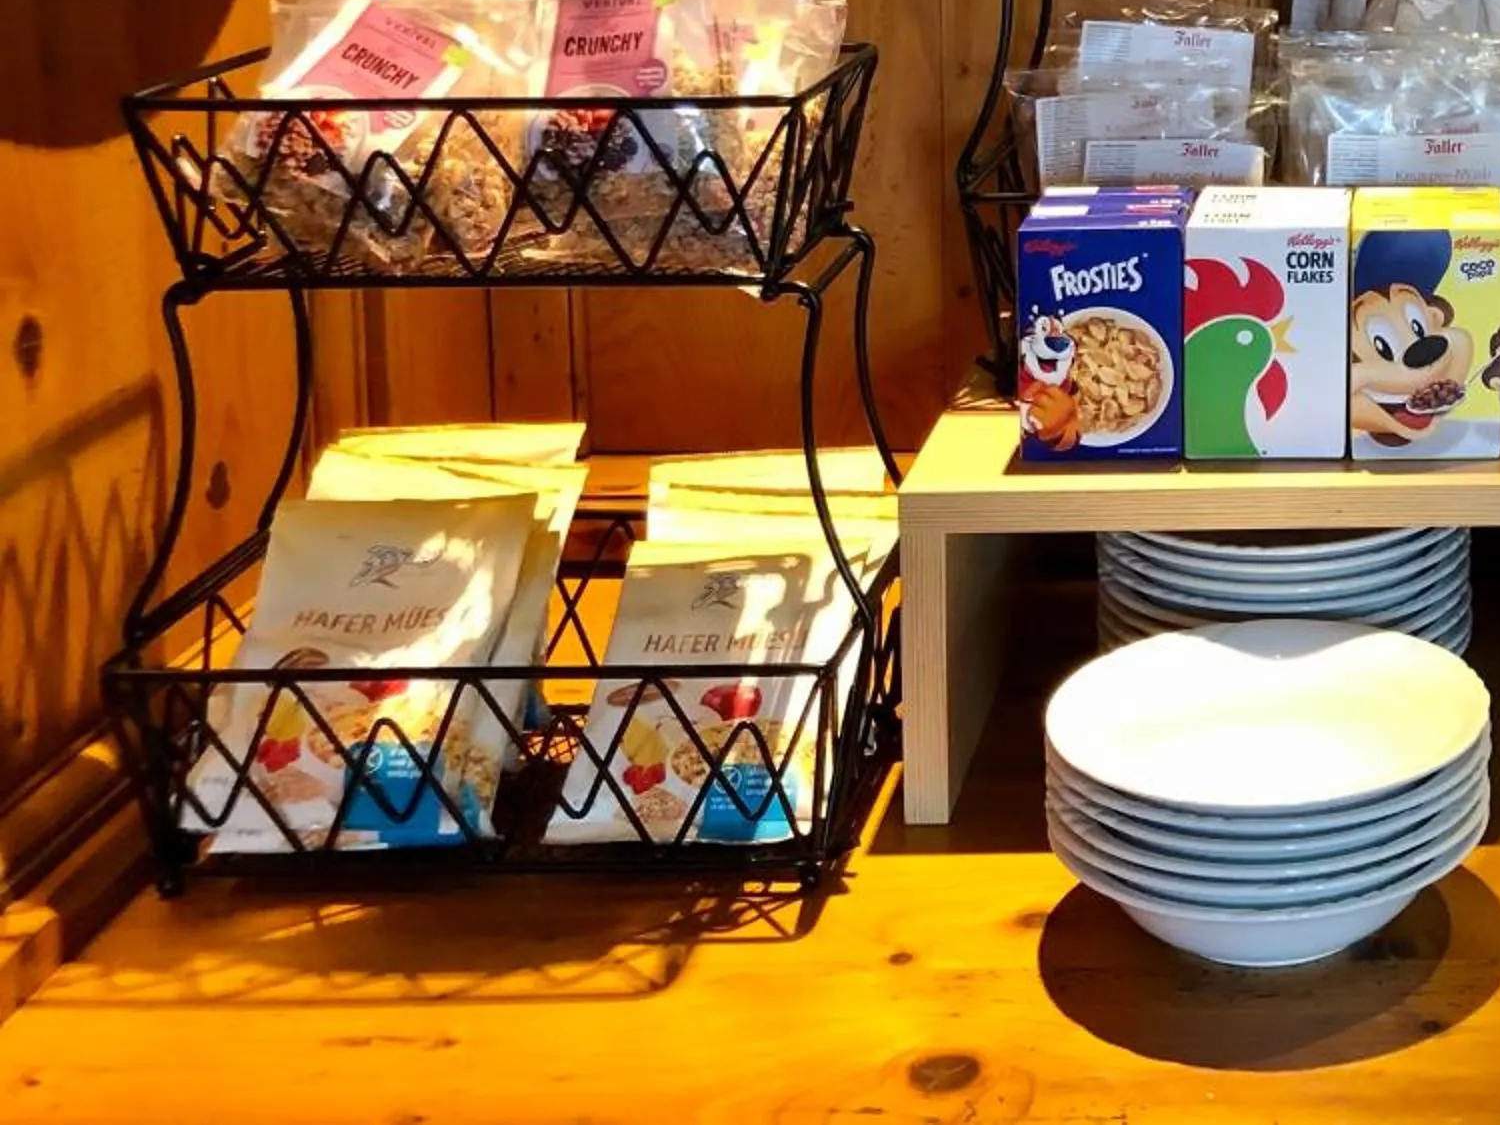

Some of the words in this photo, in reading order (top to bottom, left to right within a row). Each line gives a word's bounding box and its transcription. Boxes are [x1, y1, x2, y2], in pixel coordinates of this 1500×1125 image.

[563, 31, 644, 58] CRUNCHY
[1173, 30, 1212, 48] Faller
[341, 42, 420, 90] CRUNCHY
[1180, 142, 1219, 159] Faller
[1424, 138, 1464, 155] Faller
[1285, 250, 1335, 270] CORN
[1459, 259, 1496, 275] COCO
[1049, 255, 1144, 302] FROSTIES
[1286, 270, 1334, 284] FLAKES
[293, 609, 377, 634] HAFER
[643, 633, 721, 654] HAFER
